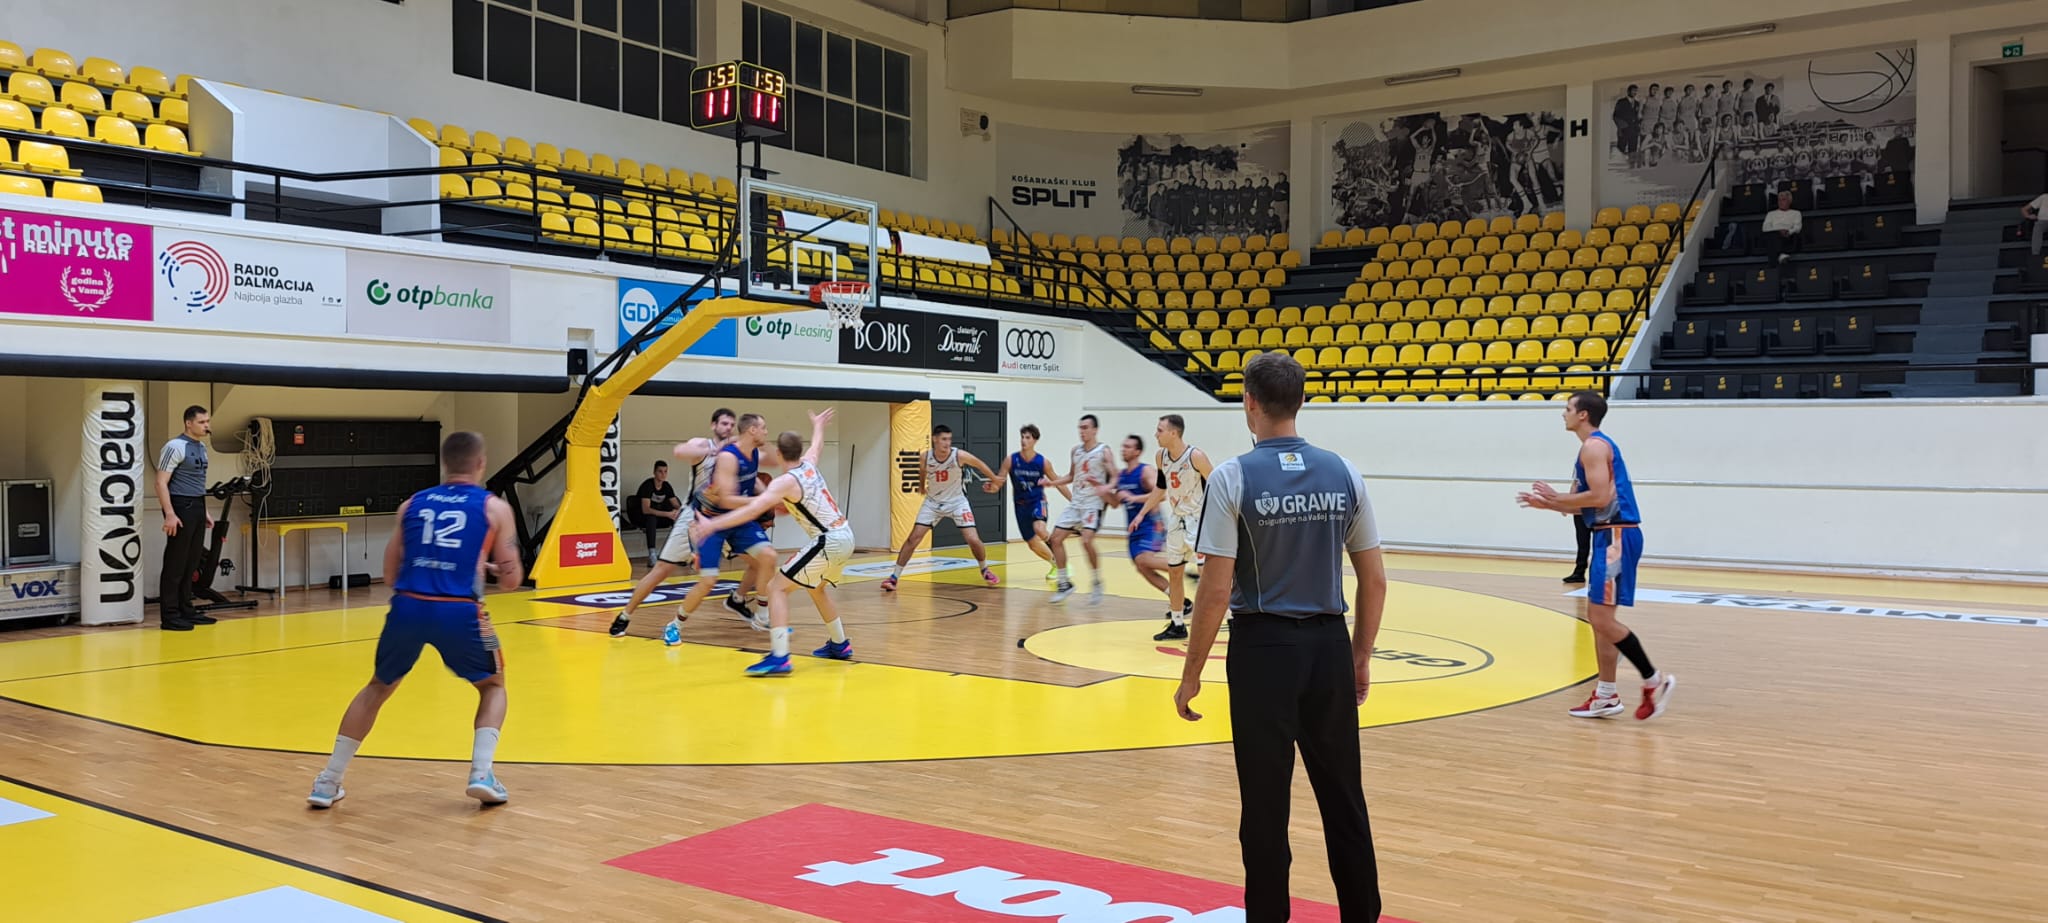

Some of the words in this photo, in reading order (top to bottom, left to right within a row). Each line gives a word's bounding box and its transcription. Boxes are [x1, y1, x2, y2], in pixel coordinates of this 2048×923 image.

[708, 65, 736, 88] 1:53
[756, 70, 783, 94] 1:53
[707, 88, 730, 119] 11
[755, 92, 777, 122] 11
[1570, 118, 1588, 138] H
[1011, 174, 1069, 186] KOŠARKAŠKI
[1072, 179, 1097, 187] KLUB
[1012, 186, 1097, 208] SPLIT
[0, 216, 16, 240] t
[23, 220, 134, 252] minute
[24, 239, 72, 256] RENT
[77, 245, 90, 258] A
[94, 246, 131, 261] CAR
[80, 267, 93, 276] 10
[234, 263, 279, 277] RADIO
[71, 277, 104, 287] godina
[234, 275, 315, 292] DALMACIJA
[234, 291, 272, 303] Najbolja
[273, 295, 303, 306] glazba
[622, 302, 656, 323] GDi
[766, 317, 792, 340] otp
[794, 322, 834, 343] Leasing
[855, 320, 911, 353] BOBIS
[1001, 360, 1019, 369] Audi
[1019, 362, 1041, 371] centar
[1042, 362, 1060, 372] Split
[934, 470, 949, 483] 19
[1170, 471, 1182, 489] 5
[99, 391, 141, 603] macron
[1281, 491, 1346, 515] GRAWE
[418, 508, 467, 548] 12
[575, 541, 599, 551] Super
[575, 549, 598, 560] Sport
[11, 579, 60, 599] VOX
[1671, 594, 2048, 626] DMIRAL
